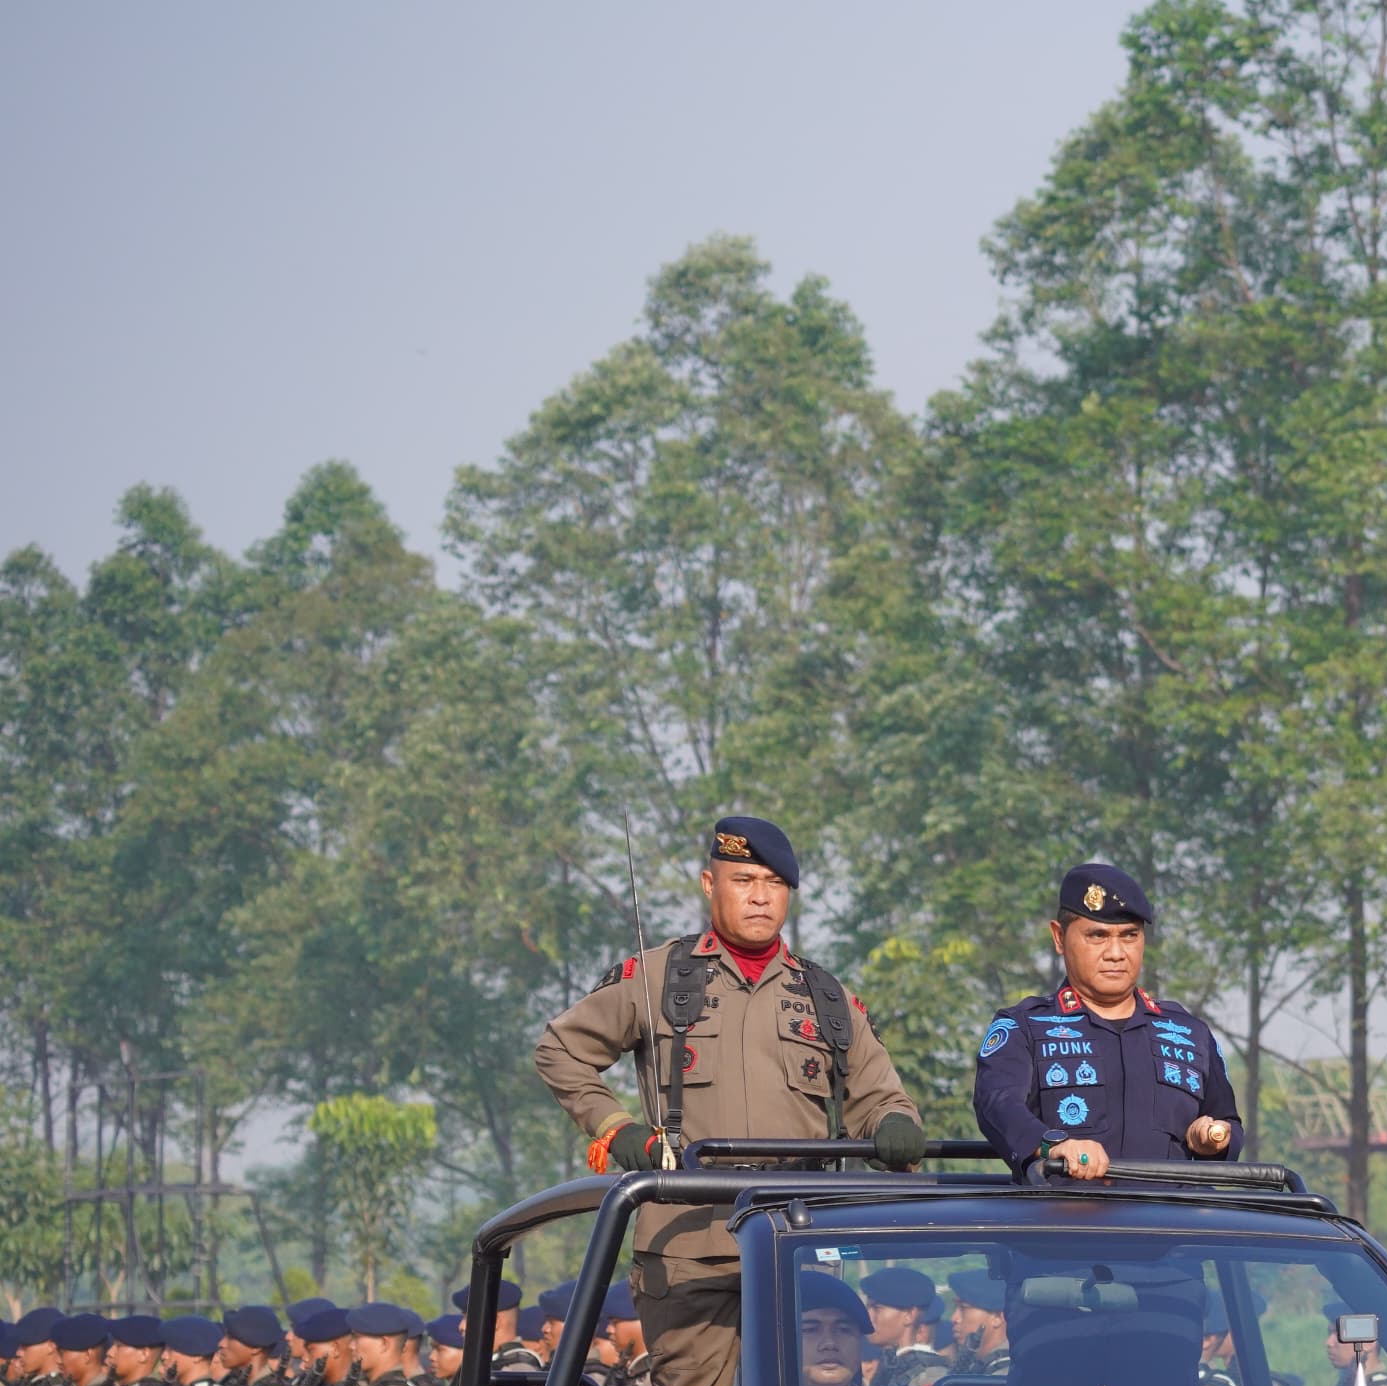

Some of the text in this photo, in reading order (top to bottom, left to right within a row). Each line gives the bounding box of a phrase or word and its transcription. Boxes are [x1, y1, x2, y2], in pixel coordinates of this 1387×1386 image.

[781, 1000, 815, 1016] POL
[1041, 1041, 1093, 1058] IPUNK
[1160, 1044, 1196, 1063] KKP
